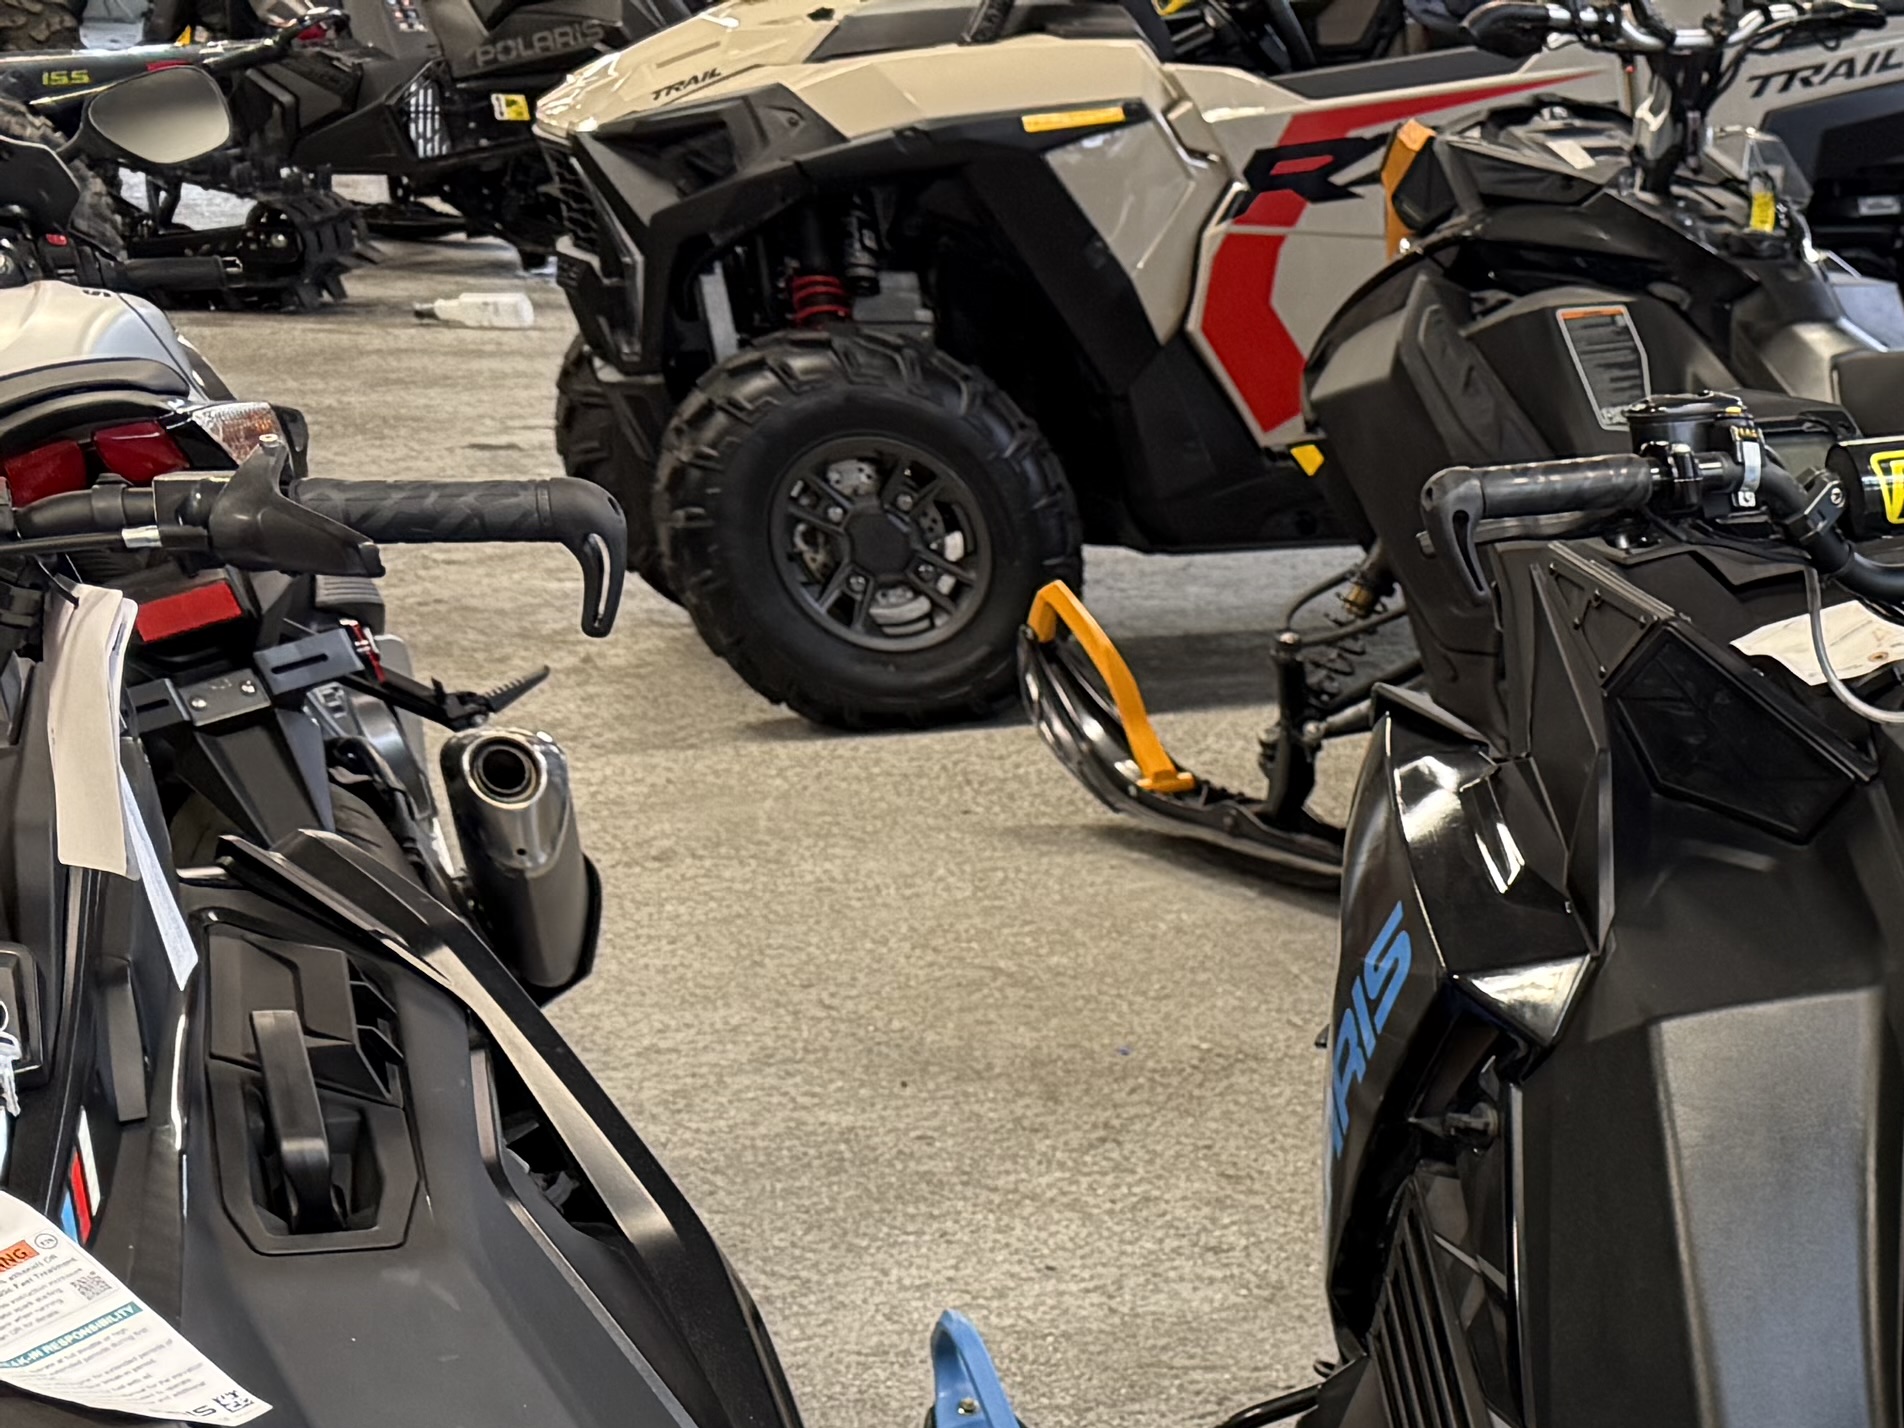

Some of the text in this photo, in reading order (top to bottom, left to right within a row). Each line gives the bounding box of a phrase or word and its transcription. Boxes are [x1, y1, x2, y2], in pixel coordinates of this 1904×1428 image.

[474, 20, 604, 69] POLARIS
[651, 67, 722, 101] TRAIL
[42, 1304, 136, 1356] RESPONSIBILITY
